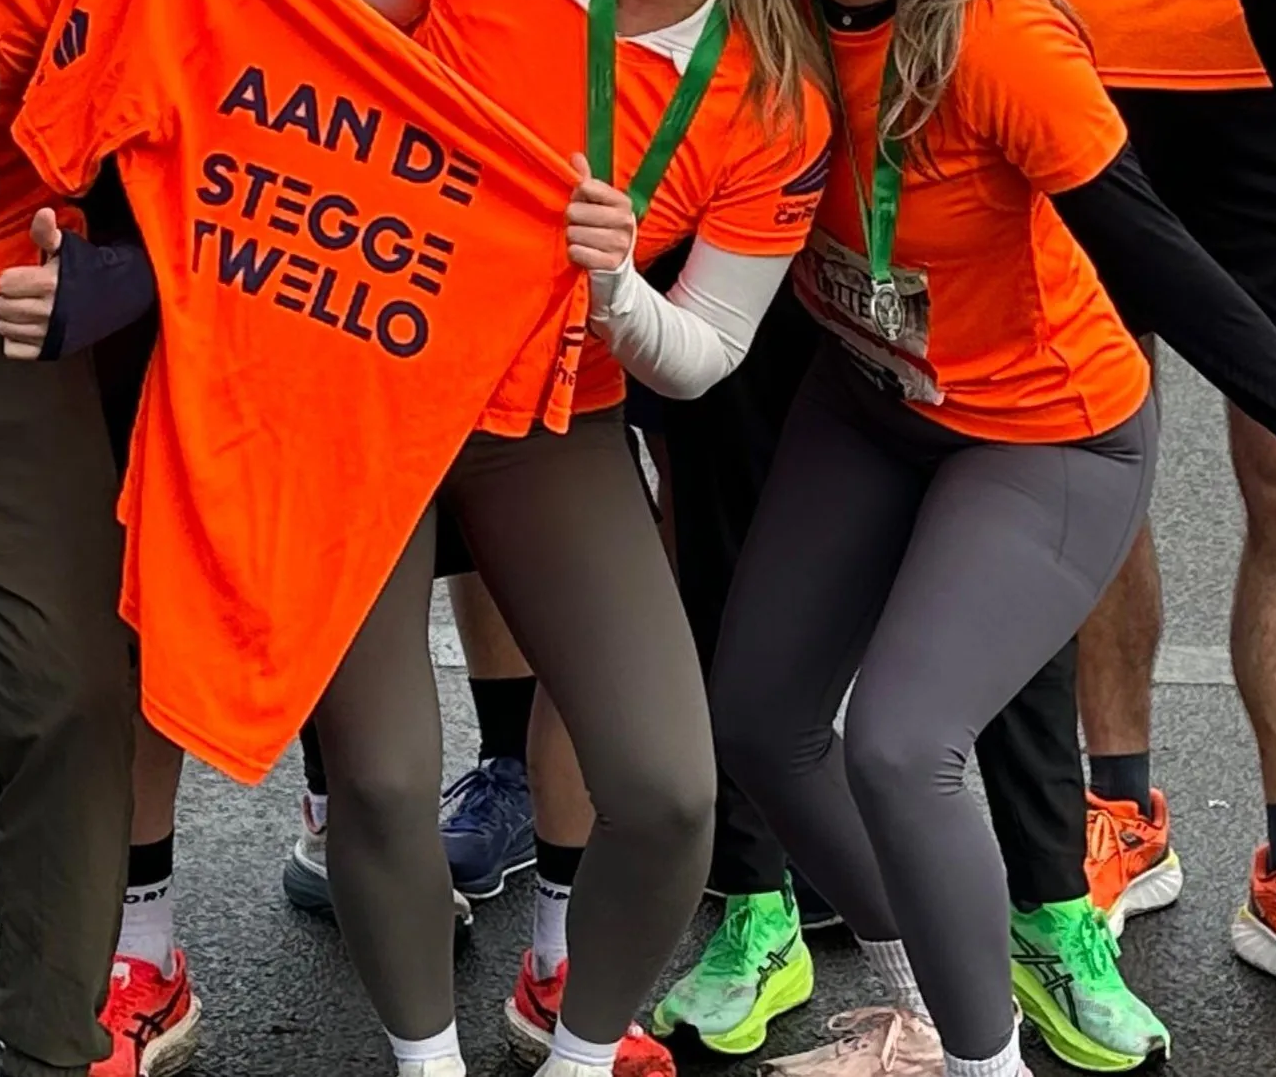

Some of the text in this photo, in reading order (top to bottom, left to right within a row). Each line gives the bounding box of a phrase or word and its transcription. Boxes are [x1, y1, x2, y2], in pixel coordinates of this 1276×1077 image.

[217, 65, 483, 206] AAN DE
[191, 220, 430, 359] TWELLO
[196, 152, 455, 296] STEGGE
